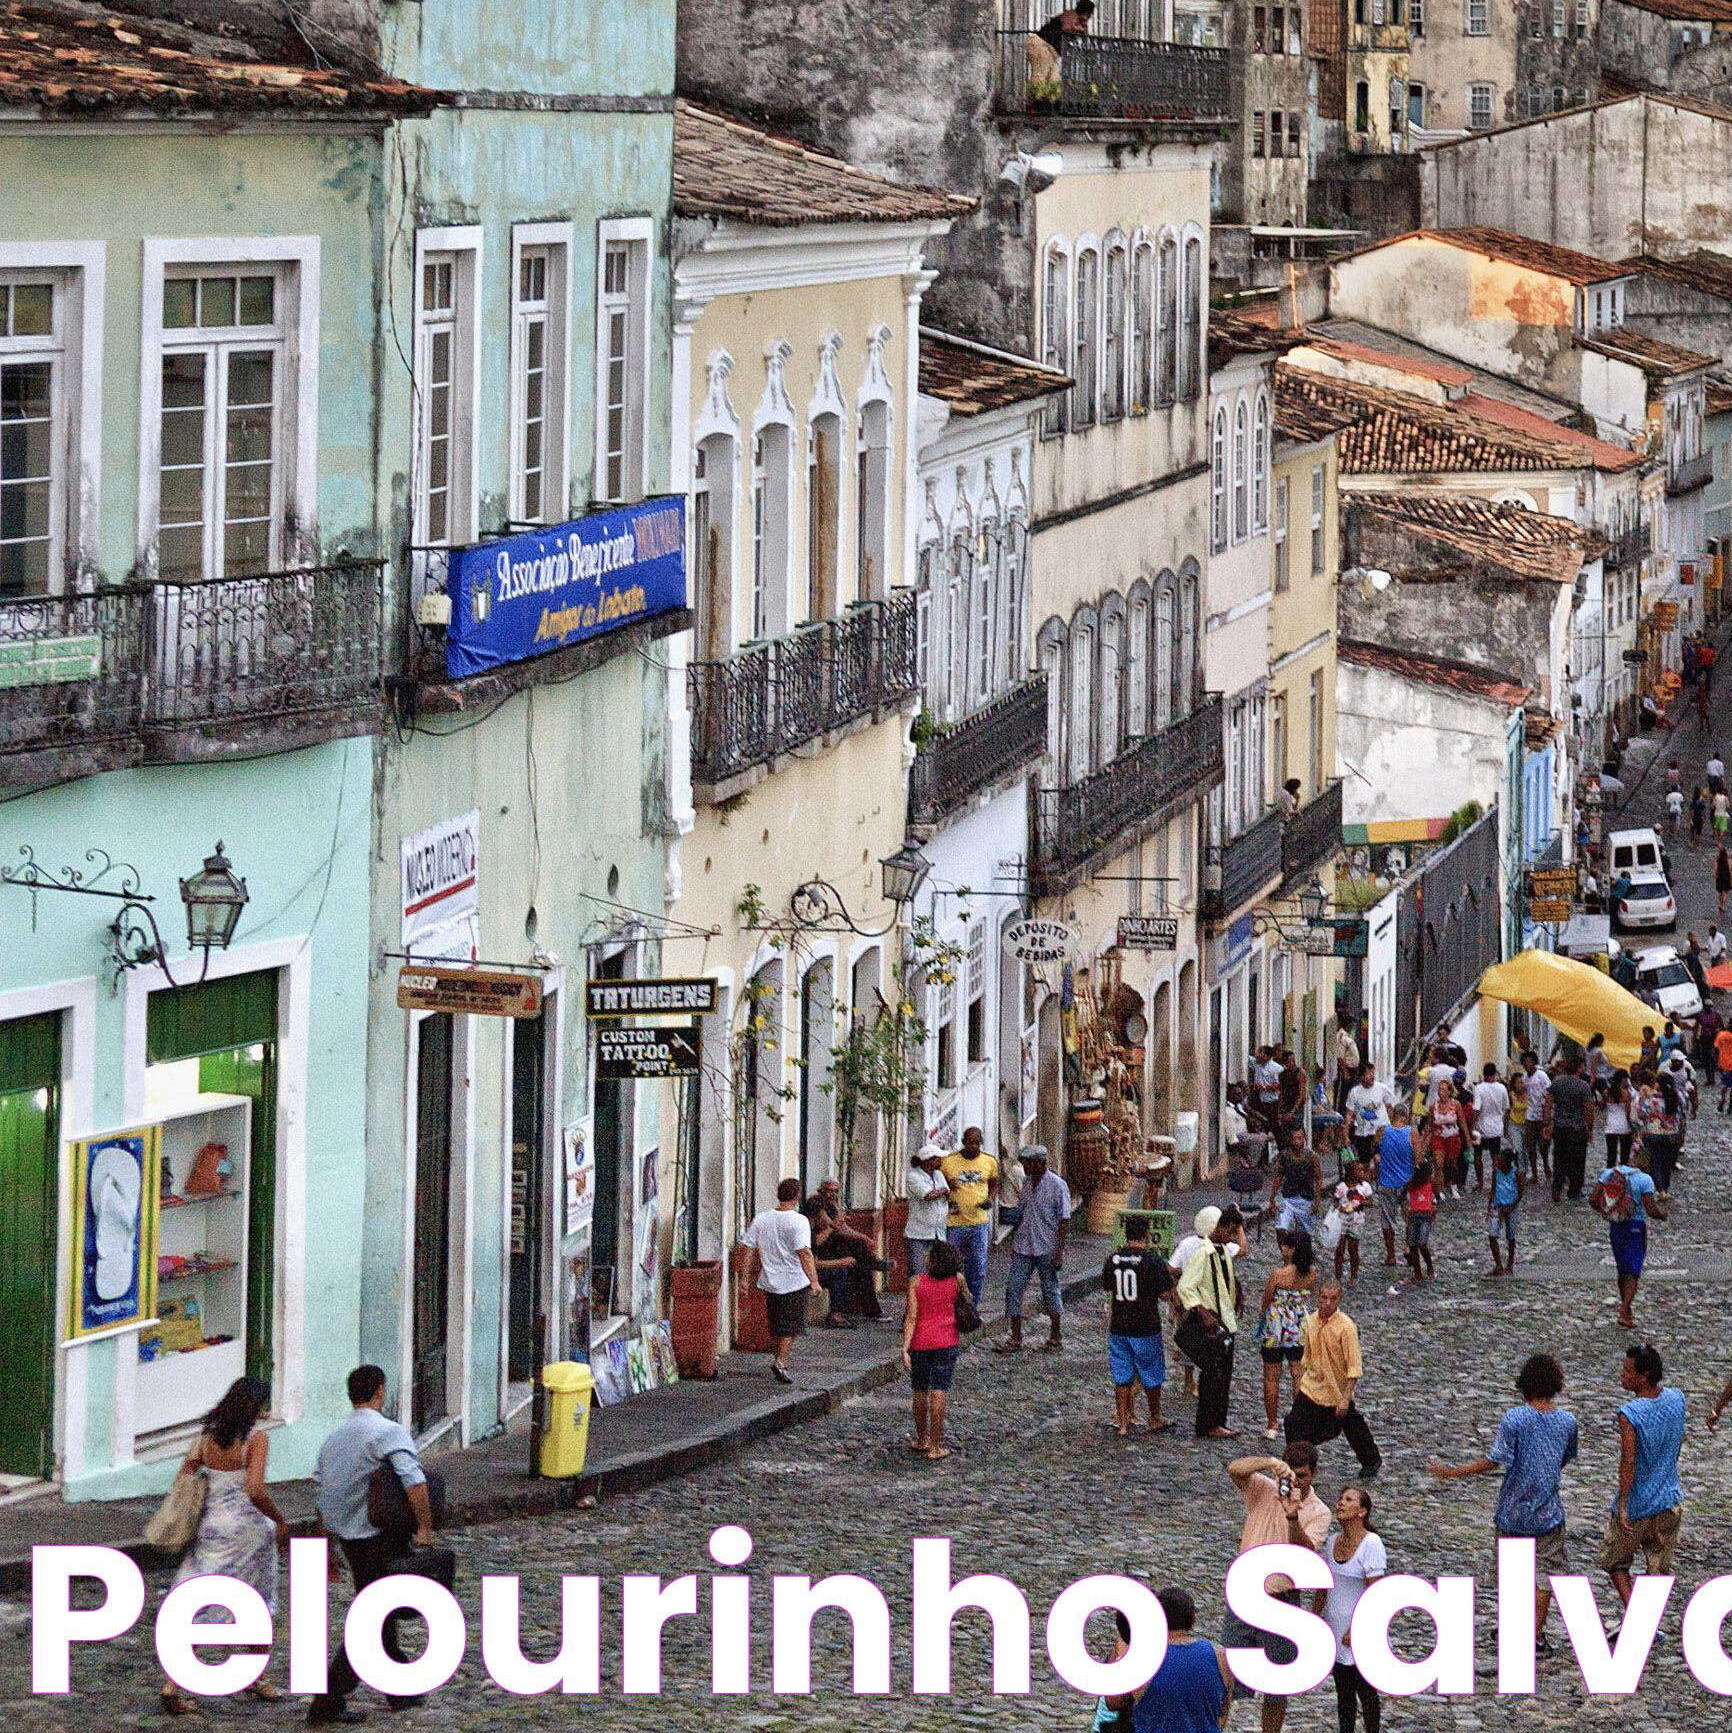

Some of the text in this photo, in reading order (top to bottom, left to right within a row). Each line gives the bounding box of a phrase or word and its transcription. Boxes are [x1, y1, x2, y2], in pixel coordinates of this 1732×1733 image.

[1031, 936, 1047, 948] DE
[1015, 949, 1066, 962] BEBIDAS
[601, 1030, 656, 1044] CUSTOM
[600, 1043, 670, 1061] TATTOO
[635, 1060, 669, 1072] POINT
[1114, 1268, 1138, 1302] 10
